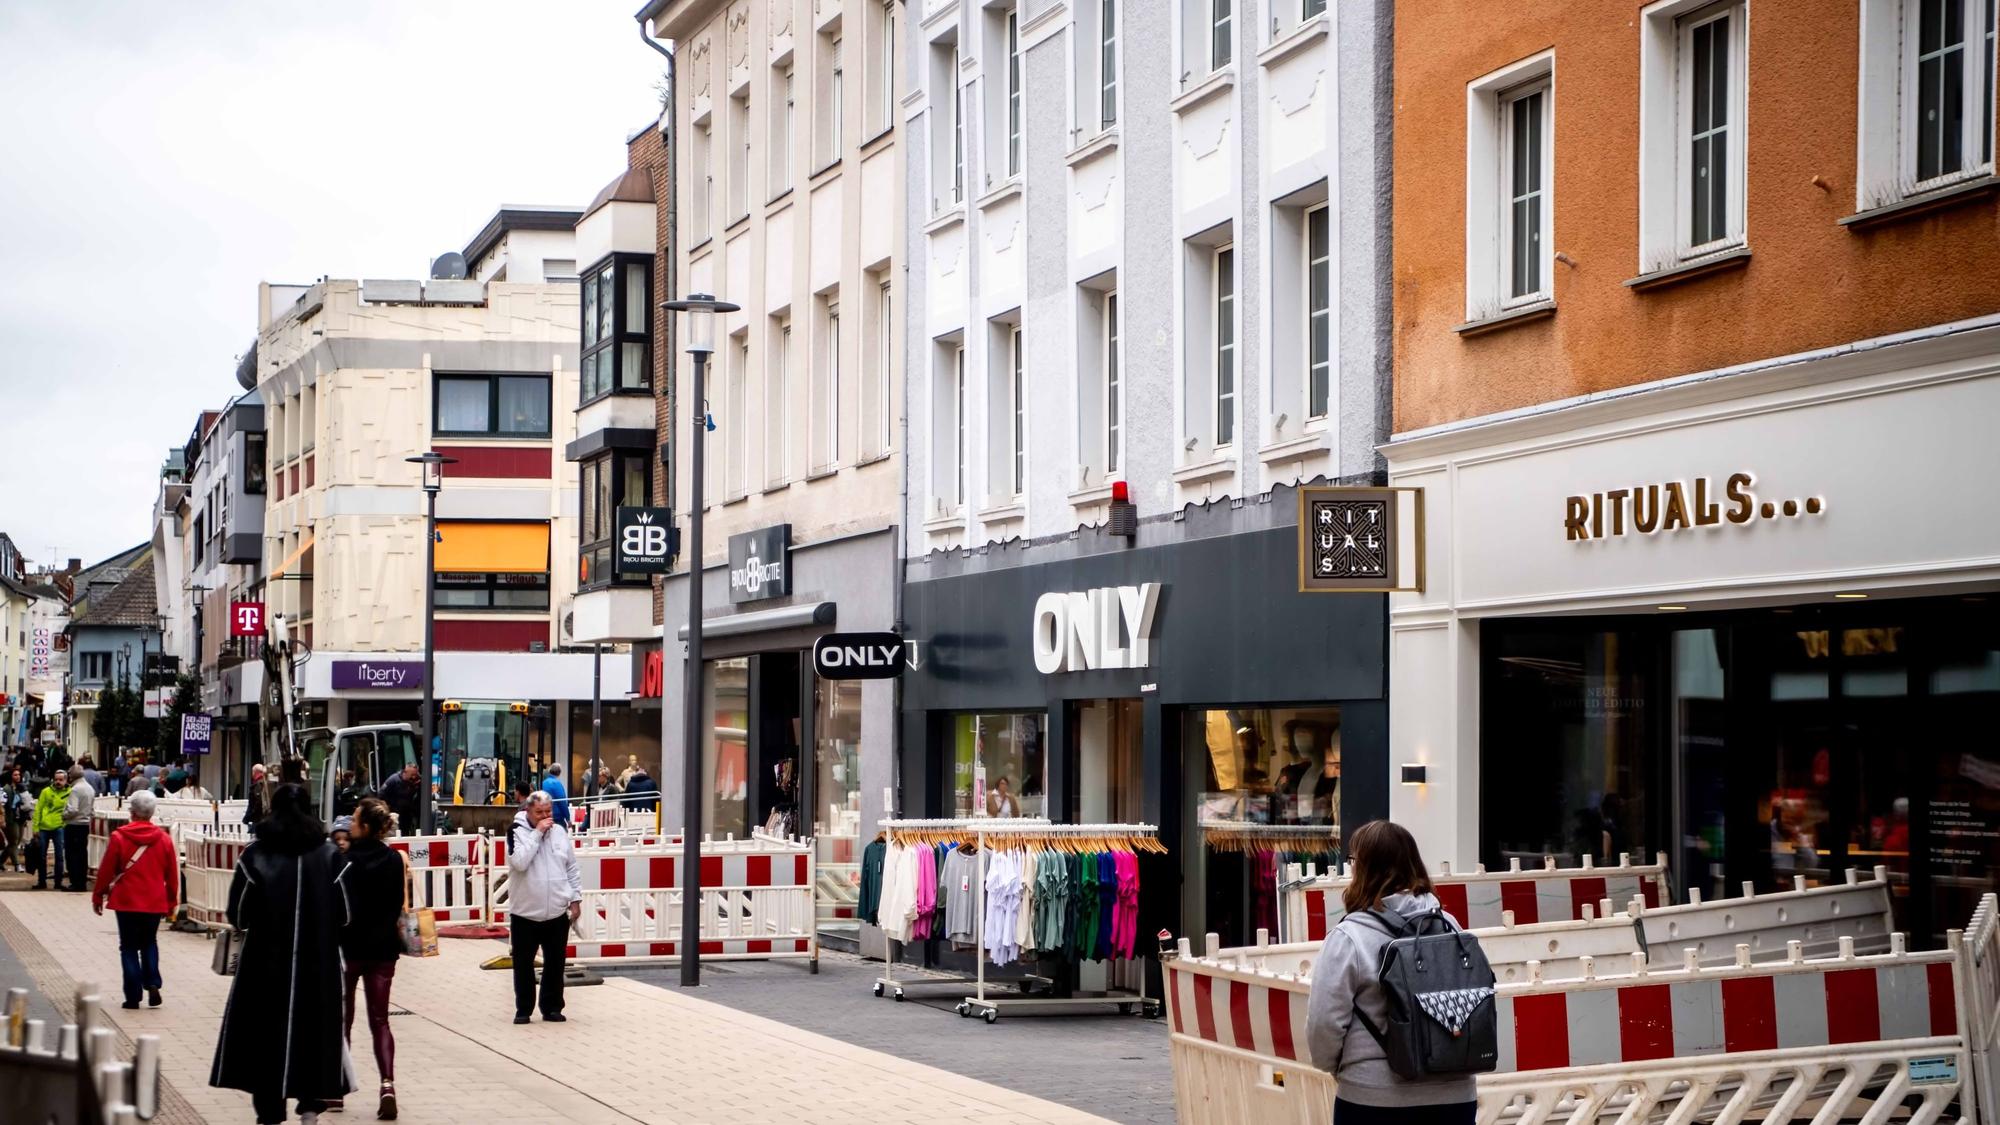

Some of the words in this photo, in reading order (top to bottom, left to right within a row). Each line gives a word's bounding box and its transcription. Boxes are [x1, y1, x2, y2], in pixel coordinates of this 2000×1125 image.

[1565, 472, 1822, 541] RITUALS...
[623, 556, 640, 564] BIJOU
[1033, 582, 1162, 675] ONLY
[820, 645, 901, 668] ONLY
[358, 663, 406, 684] liberty
[184, 730, 210, 741] LOCH
[185, 722, 211, 731] ARSCH
